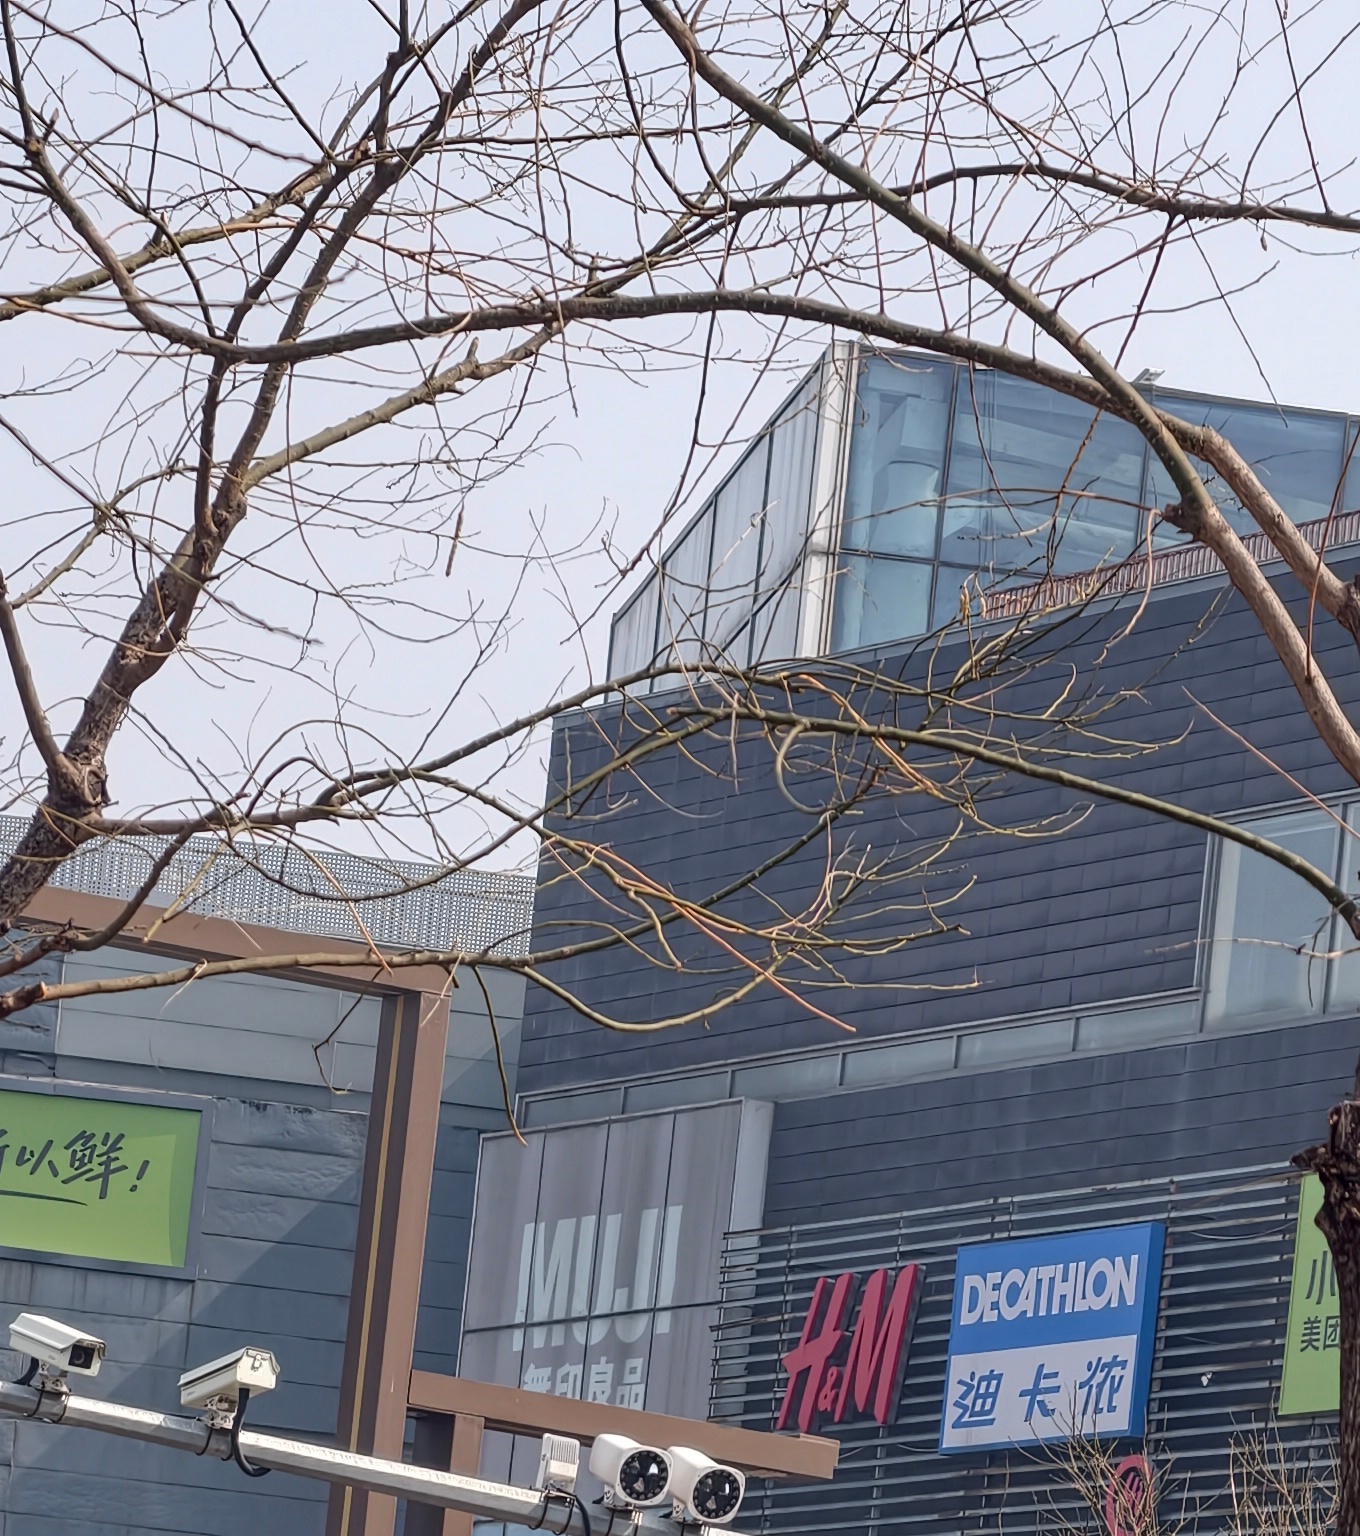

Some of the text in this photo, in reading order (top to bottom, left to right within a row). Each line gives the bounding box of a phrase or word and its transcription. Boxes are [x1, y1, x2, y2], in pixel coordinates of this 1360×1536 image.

[513, 1204, 683, 1352] MUJI
[960, 1254, 1139, 1326] DECATHLON
[522, 1356, 646, 1411] 無印良品
[776, 1263, 919, 1434] H&M
[951, 1355, 1128, 1430] 迪卡侬
